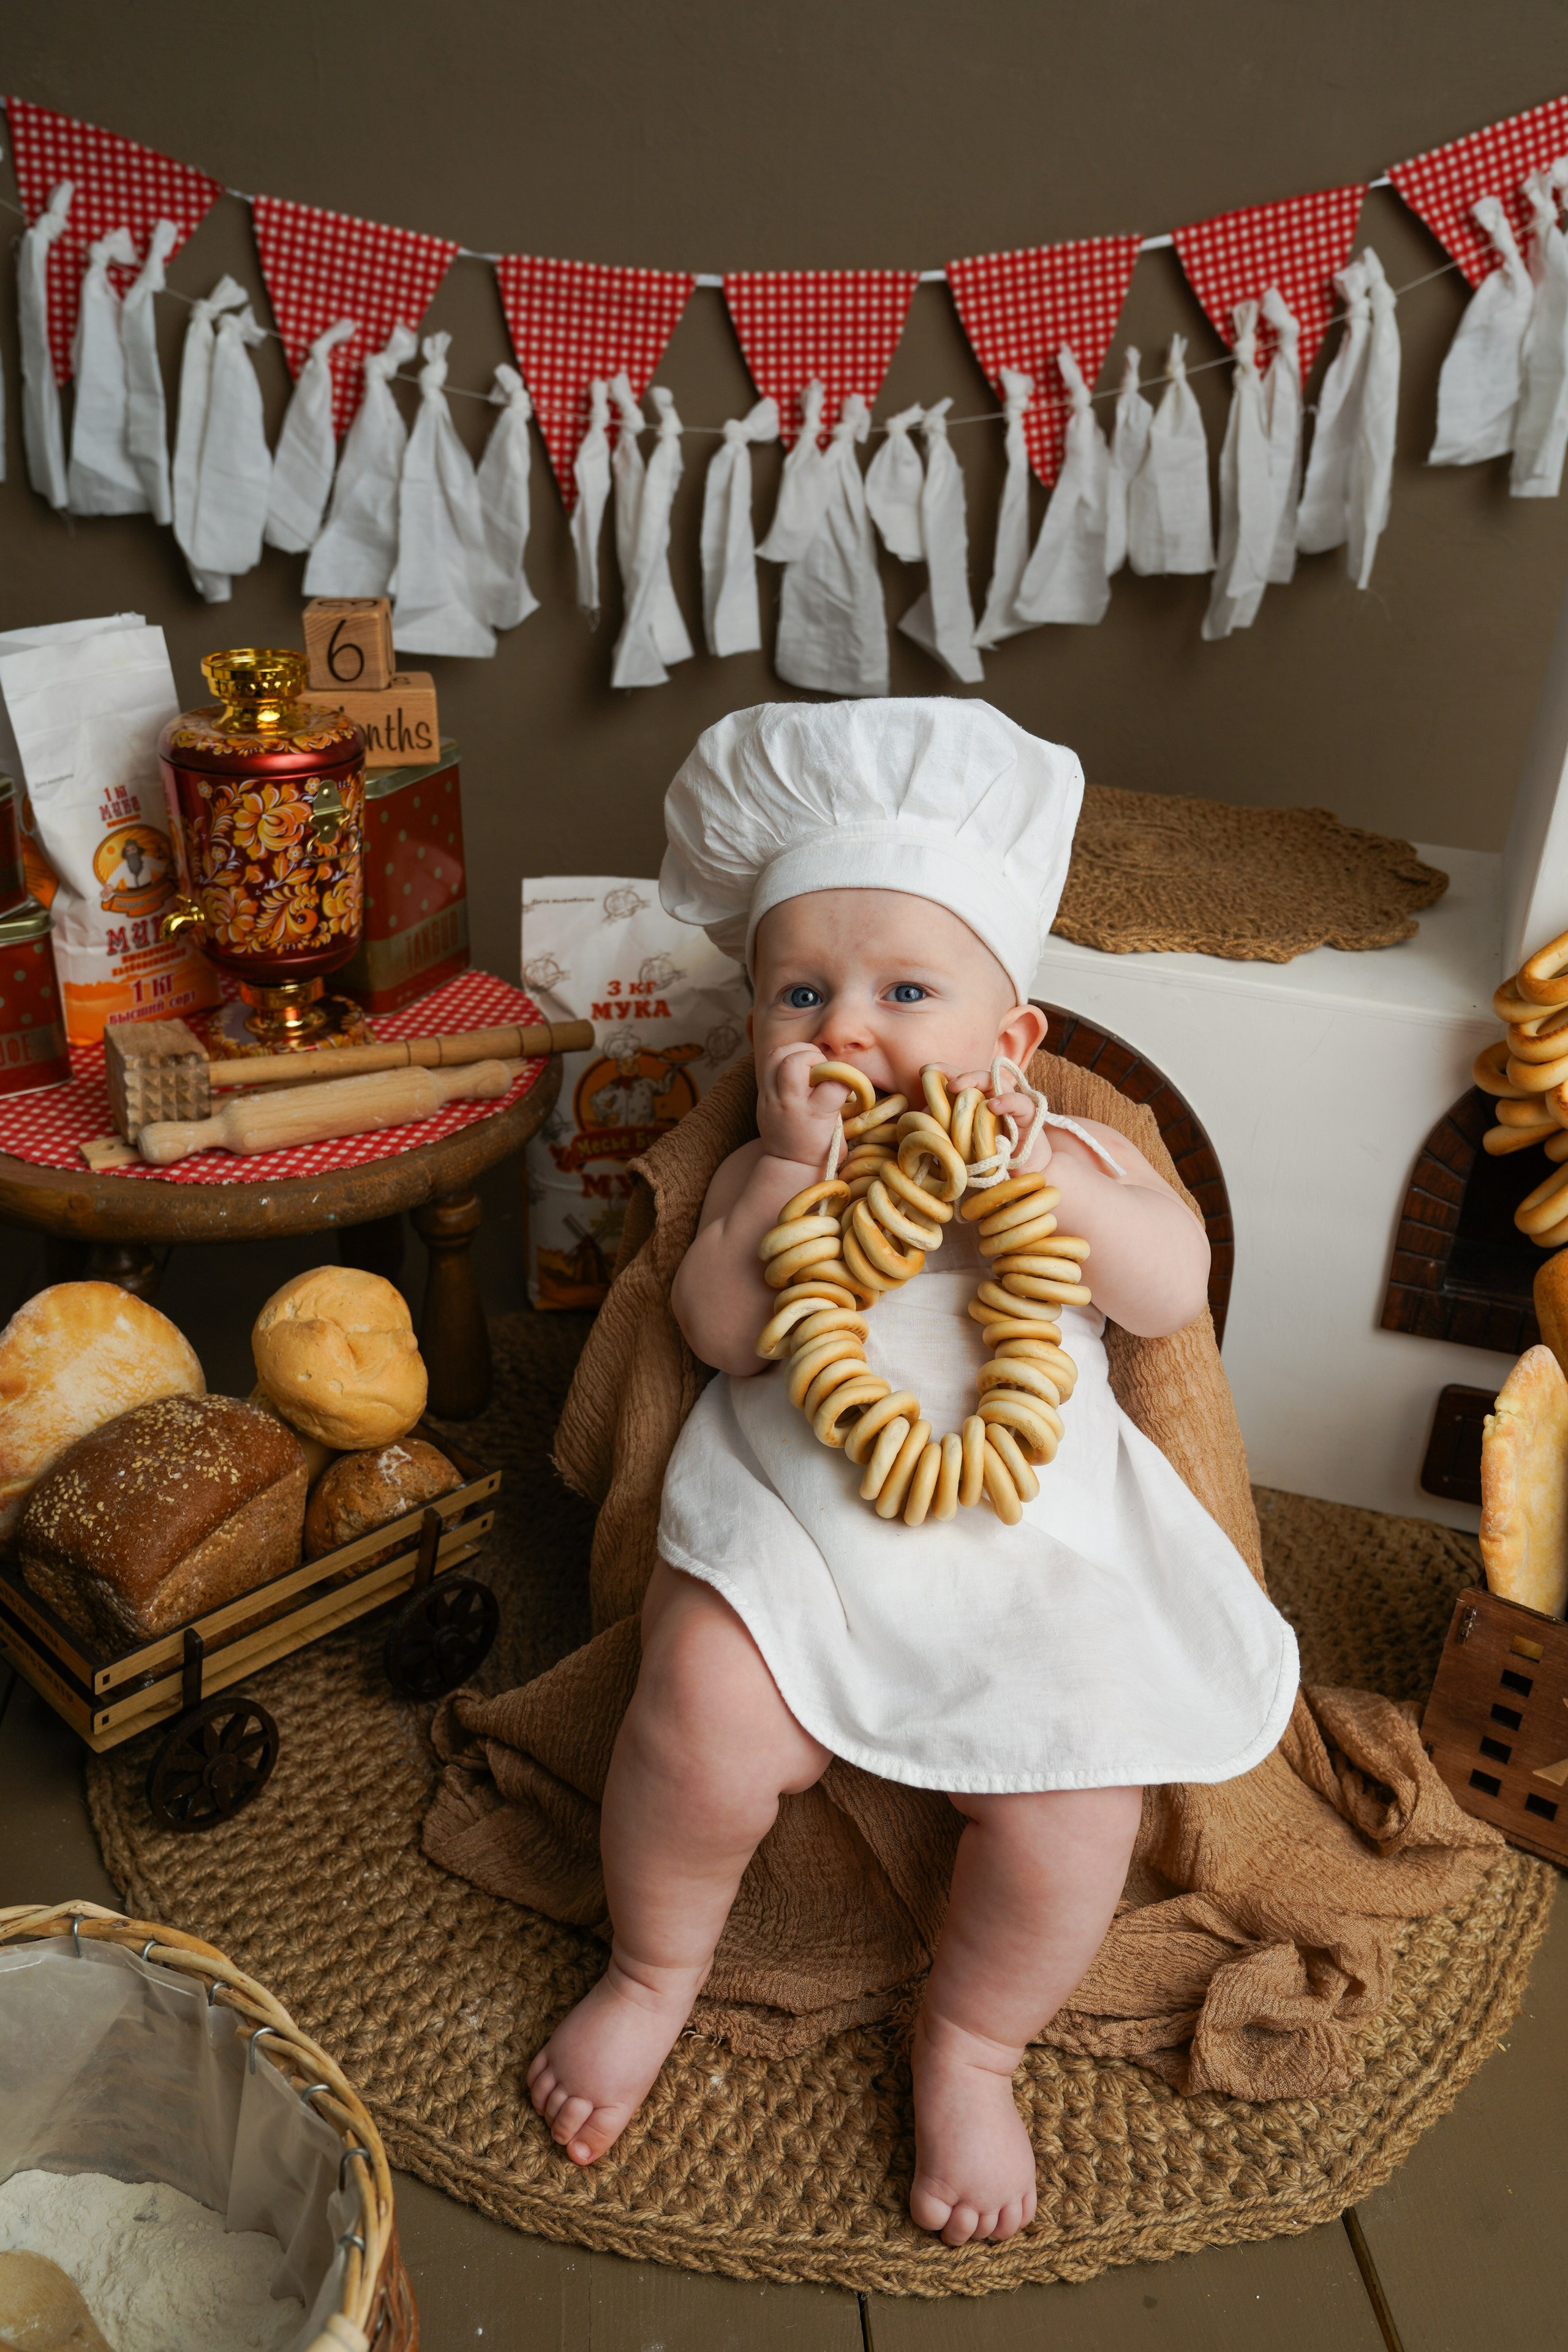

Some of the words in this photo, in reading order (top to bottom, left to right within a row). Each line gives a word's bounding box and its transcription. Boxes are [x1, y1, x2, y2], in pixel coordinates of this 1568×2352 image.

[327, 619, 364, 682] 6
[358, 707, 432, 752] nths
[133, 979, 143, 1003] 1
[607, 979, 622, 997] 3
[591, 998, 671, 1021] МУКА
[582, 1174, 633, 1199] МУ
